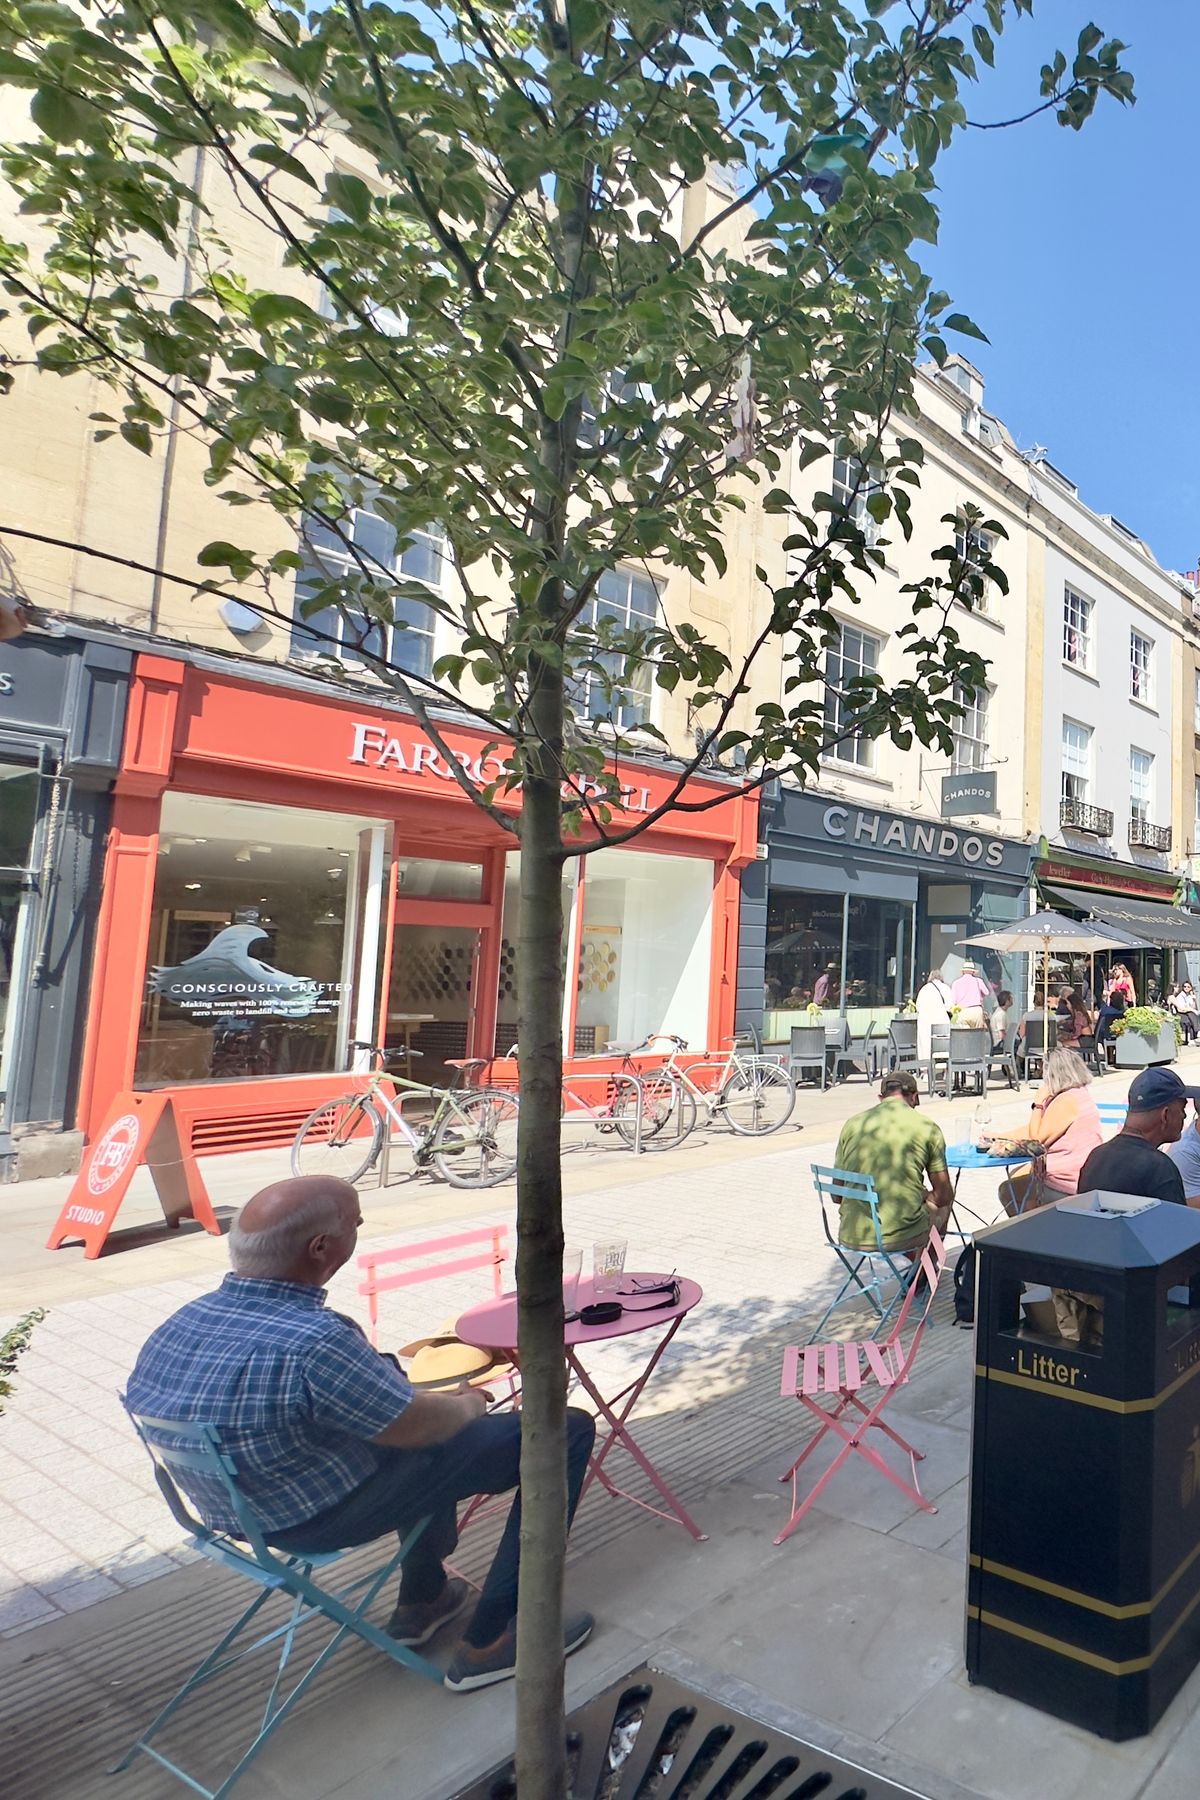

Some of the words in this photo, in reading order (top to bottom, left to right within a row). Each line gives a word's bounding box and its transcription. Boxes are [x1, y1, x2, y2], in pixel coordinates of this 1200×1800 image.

[346, 721, 523, 790] FARRO
[576, 772, 658, 814] BLL
[943, 787, 992, 803] CHANDOS
[822, 805, 1005, 866] CHANDOS
[170, 983, 282, 994] CONSCIOUSLY
[289, 982, 353, 993] CRAFTED
[180, 1000, 212, 1009] Making
[259, 999, 278, 1007] 100%
[192, 1009, 210, 1017] zero
[212, 1009, 235, 1017] waste
[245, 1008, 273, 1016] landfill
[65, 1205, 105, 1226] STUDIO
[1016, 1349, 1080, 1387] Litter
